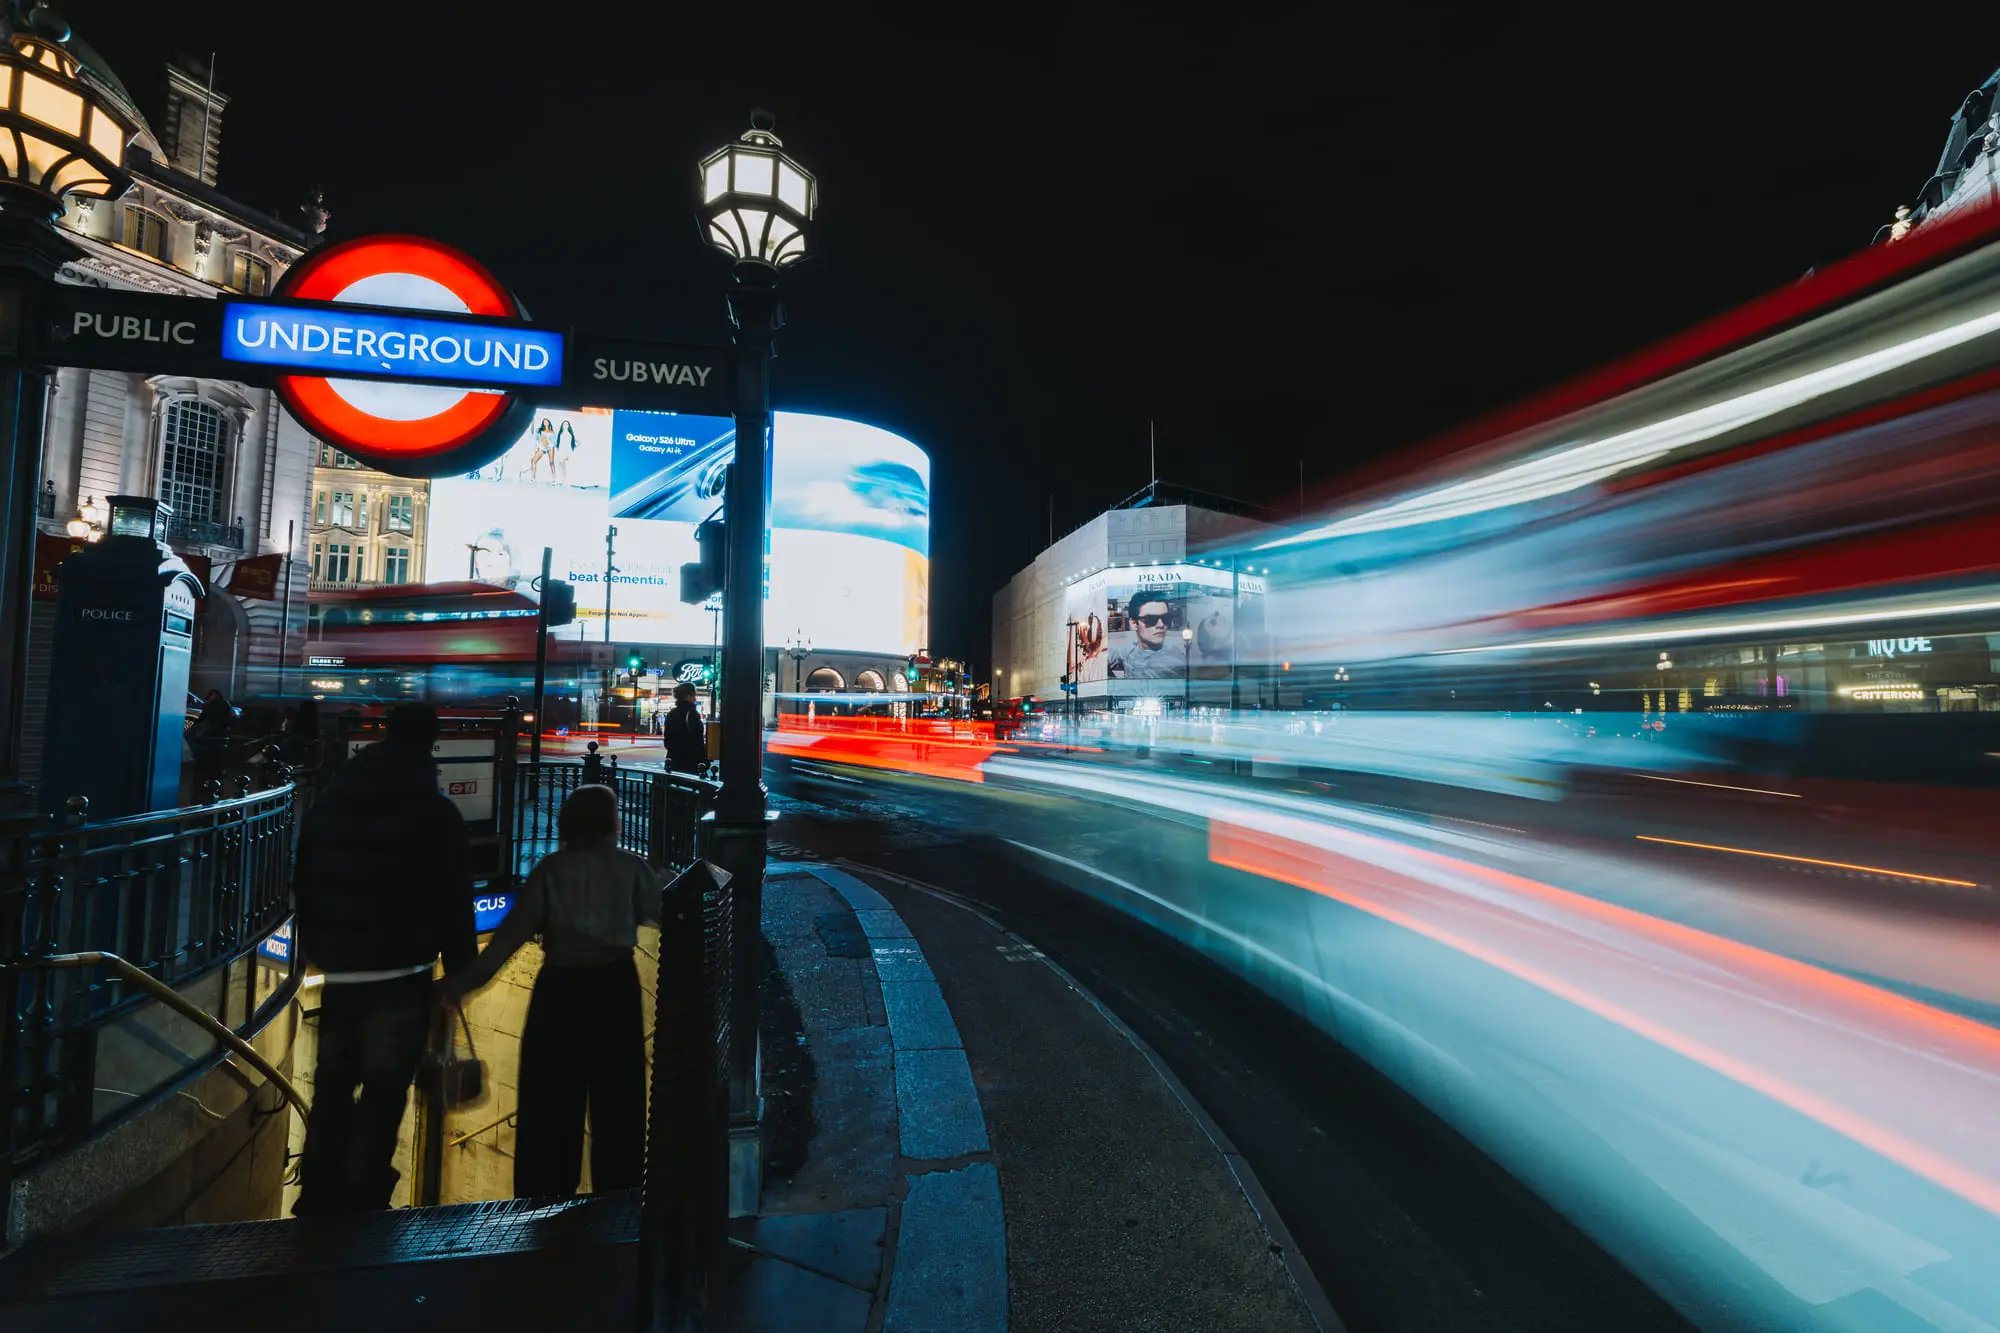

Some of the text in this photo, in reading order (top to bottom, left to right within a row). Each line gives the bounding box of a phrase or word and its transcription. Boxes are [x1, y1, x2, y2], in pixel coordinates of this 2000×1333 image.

[73, 311, 196, 345] PUBLIC
[236, 318, 550, 371] UNDERGROUND
[593, 358, 712, 388] SUBWAY
[626, 433, 696, 447] Galaxy S26 Ultra
[639, 444, 665, 454] Galaxy
[569, 571, 599, 583] beat
[1138, 572, 1182, 582] PRADA
[1239, 580, 1263, 592] RADA
[81, 608, 134, 621] POLICE
[1852, 690, 1925, 700] CRITERION
[473, 896, 507, 914] CUS
